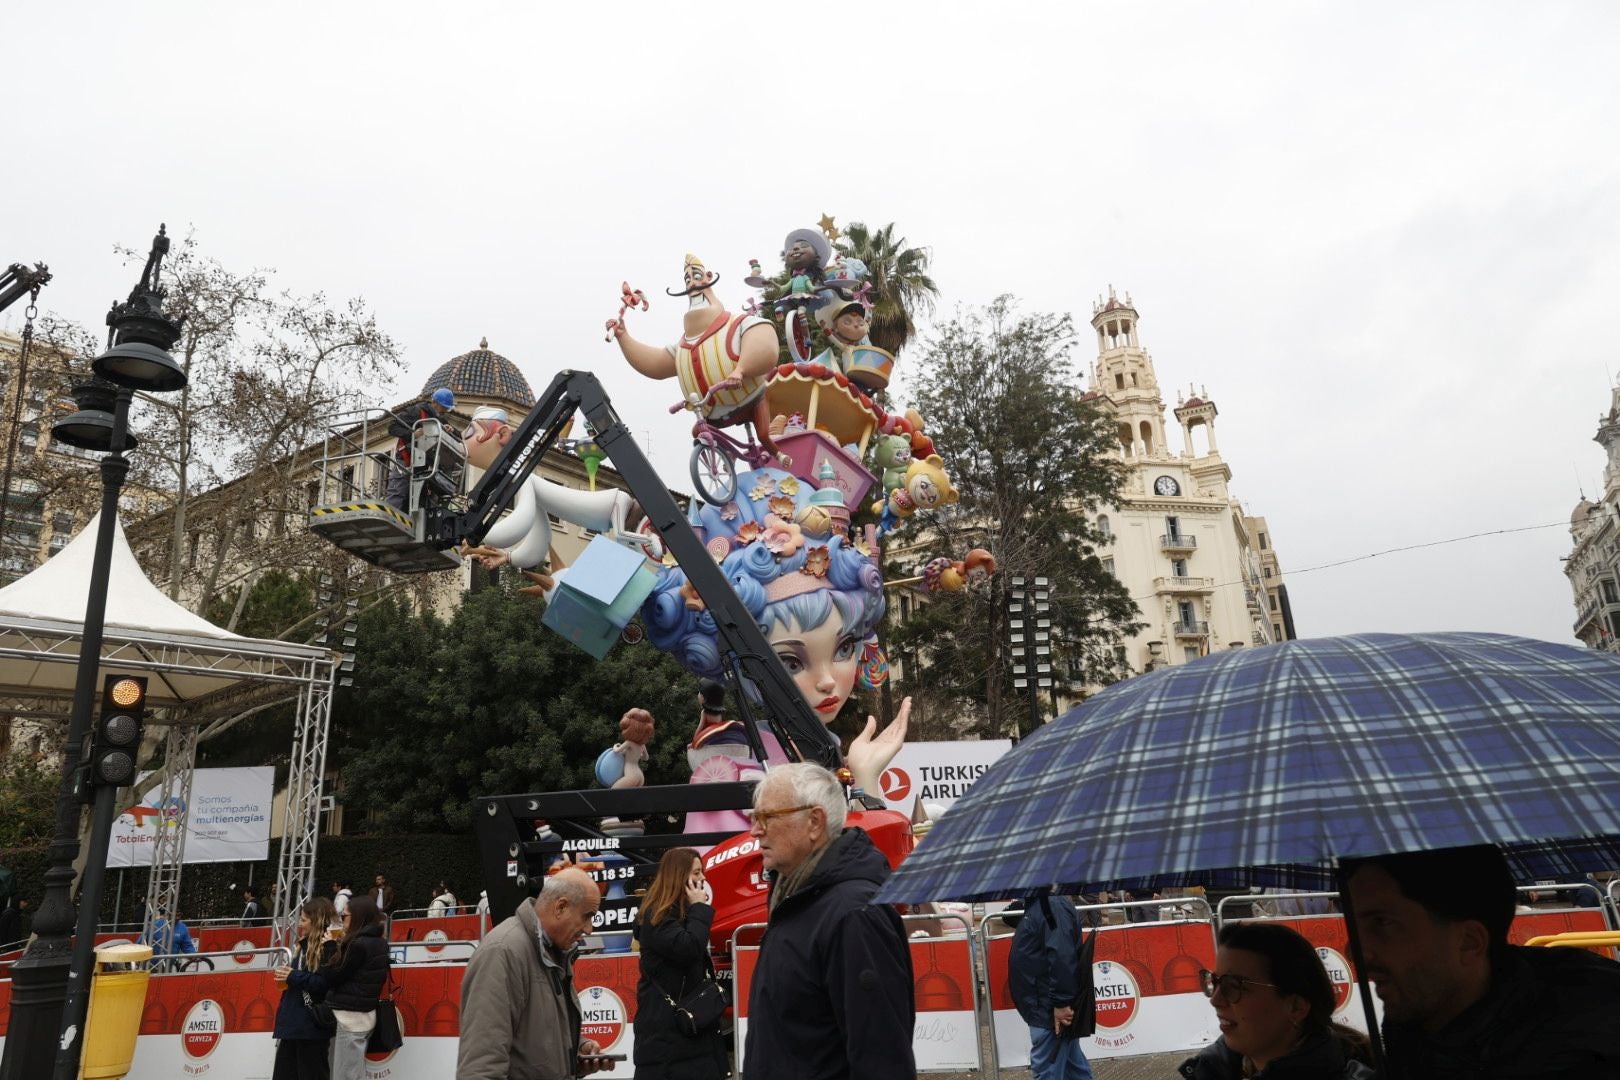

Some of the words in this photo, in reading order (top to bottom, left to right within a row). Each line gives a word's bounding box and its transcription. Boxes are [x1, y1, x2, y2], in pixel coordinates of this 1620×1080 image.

[919, 764, 989, 782] TURKIS
[920, 783, 972, 800] AIRLI
[198, 796, 231, 805] Somos
[210, 803, 258, 814] compañía
[196, 814, 264, 824] multienergías
[561, 838, 620, 851] ALQUILER
[602, 868, 616, 880] 18
[618, 866, 635, 878] 35
[590, 906, 639, 928] OPEA
[1328, 969, 1345, 981] TEL
[1094, 984, 1130, 998] MSTEL
[1095, 1001, 1128, 1012] ERVEZA
[582, 1010, 617, 1021] MSTEL
[188, 1021, 217, 1031] AMSTEL
[1114, 1032, 1135, 1047] MALTA
